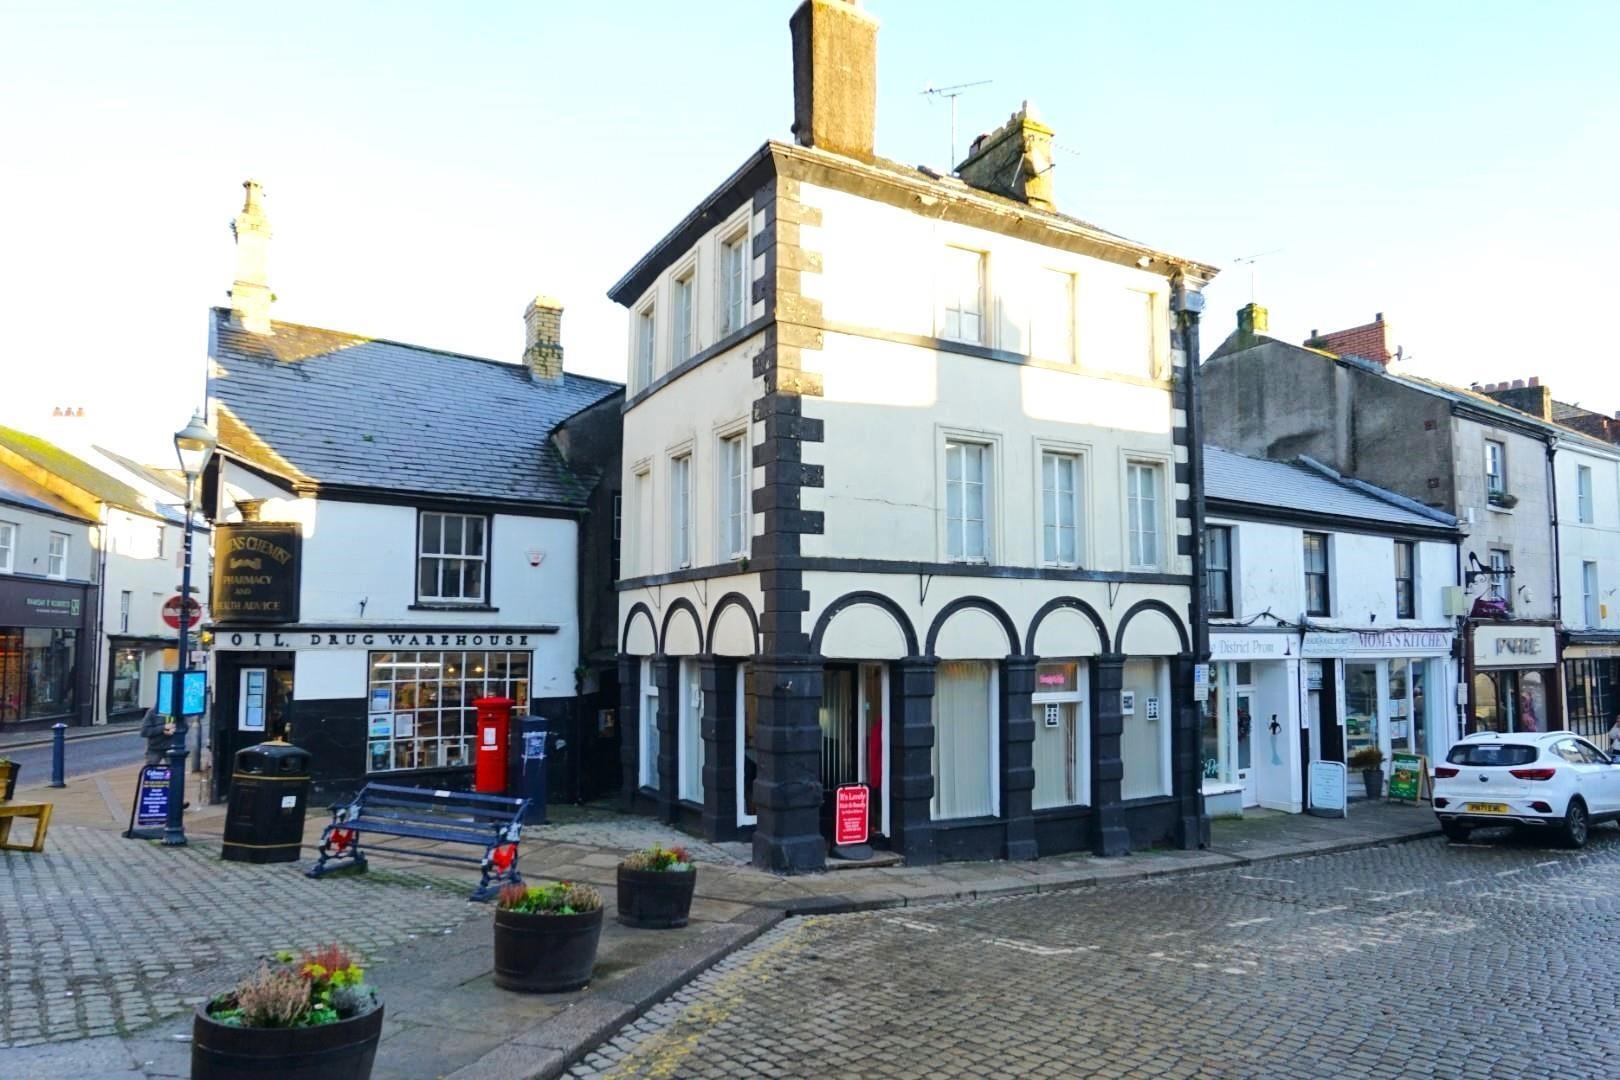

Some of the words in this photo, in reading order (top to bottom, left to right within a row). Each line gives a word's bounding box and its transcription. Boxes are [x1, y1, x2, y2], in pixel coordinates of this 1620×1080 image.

[246, 536, 292, 565] CHEMIST
[222, 575, 272, 585] PHARMACY
[234, 587, 252, 595] AND
[244, 601, 280, 610] ADVICE
[310, 634, 374, 645] DRUG
[388, 635, 528, 646] WAREHOUSE
[1402, 632, 1448, 648] KITCHEN
[1220, 639, 1250, 654] District
